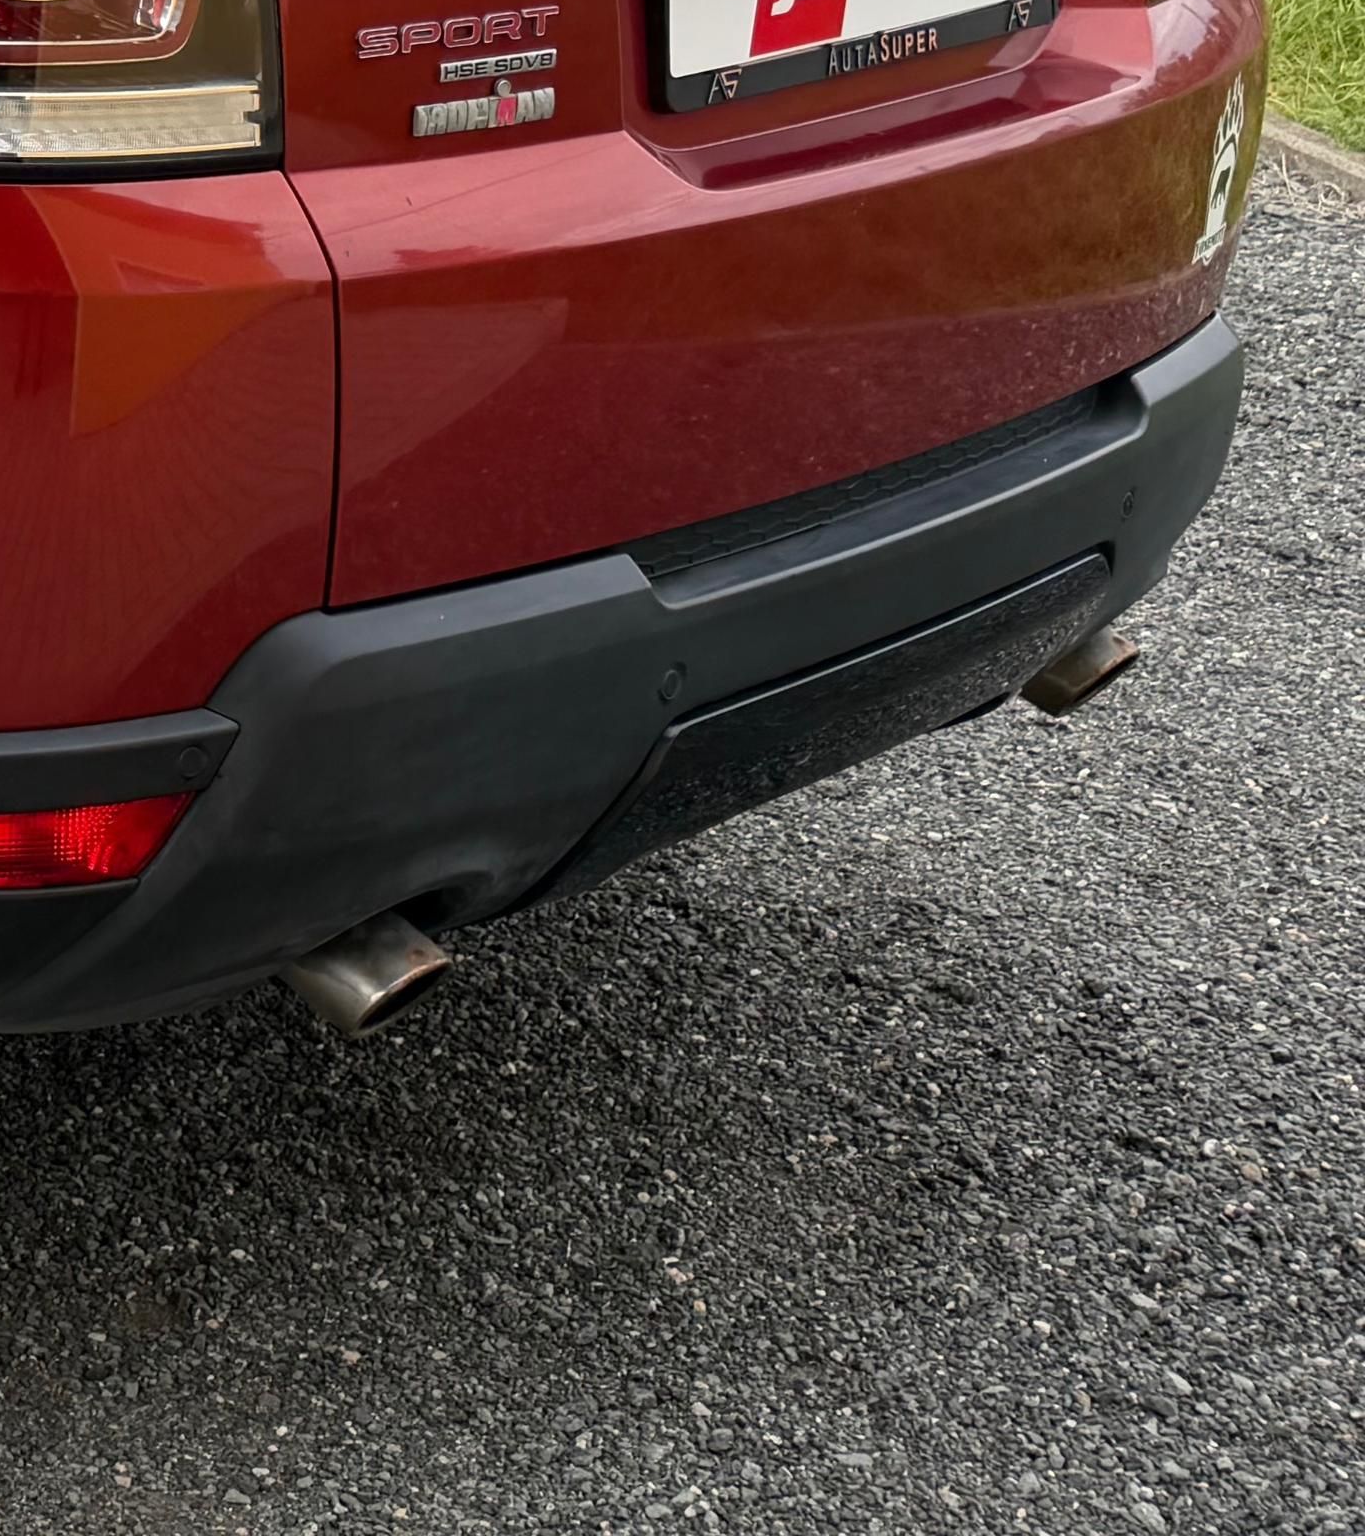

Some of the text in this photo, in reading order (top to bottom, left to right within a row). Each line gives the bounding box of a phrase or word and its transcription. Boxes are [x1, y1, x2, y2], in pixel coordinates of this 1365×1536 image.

[357, 5, 560, 59] SPORT
[443, 52, 555, 80] HSE SDV8
